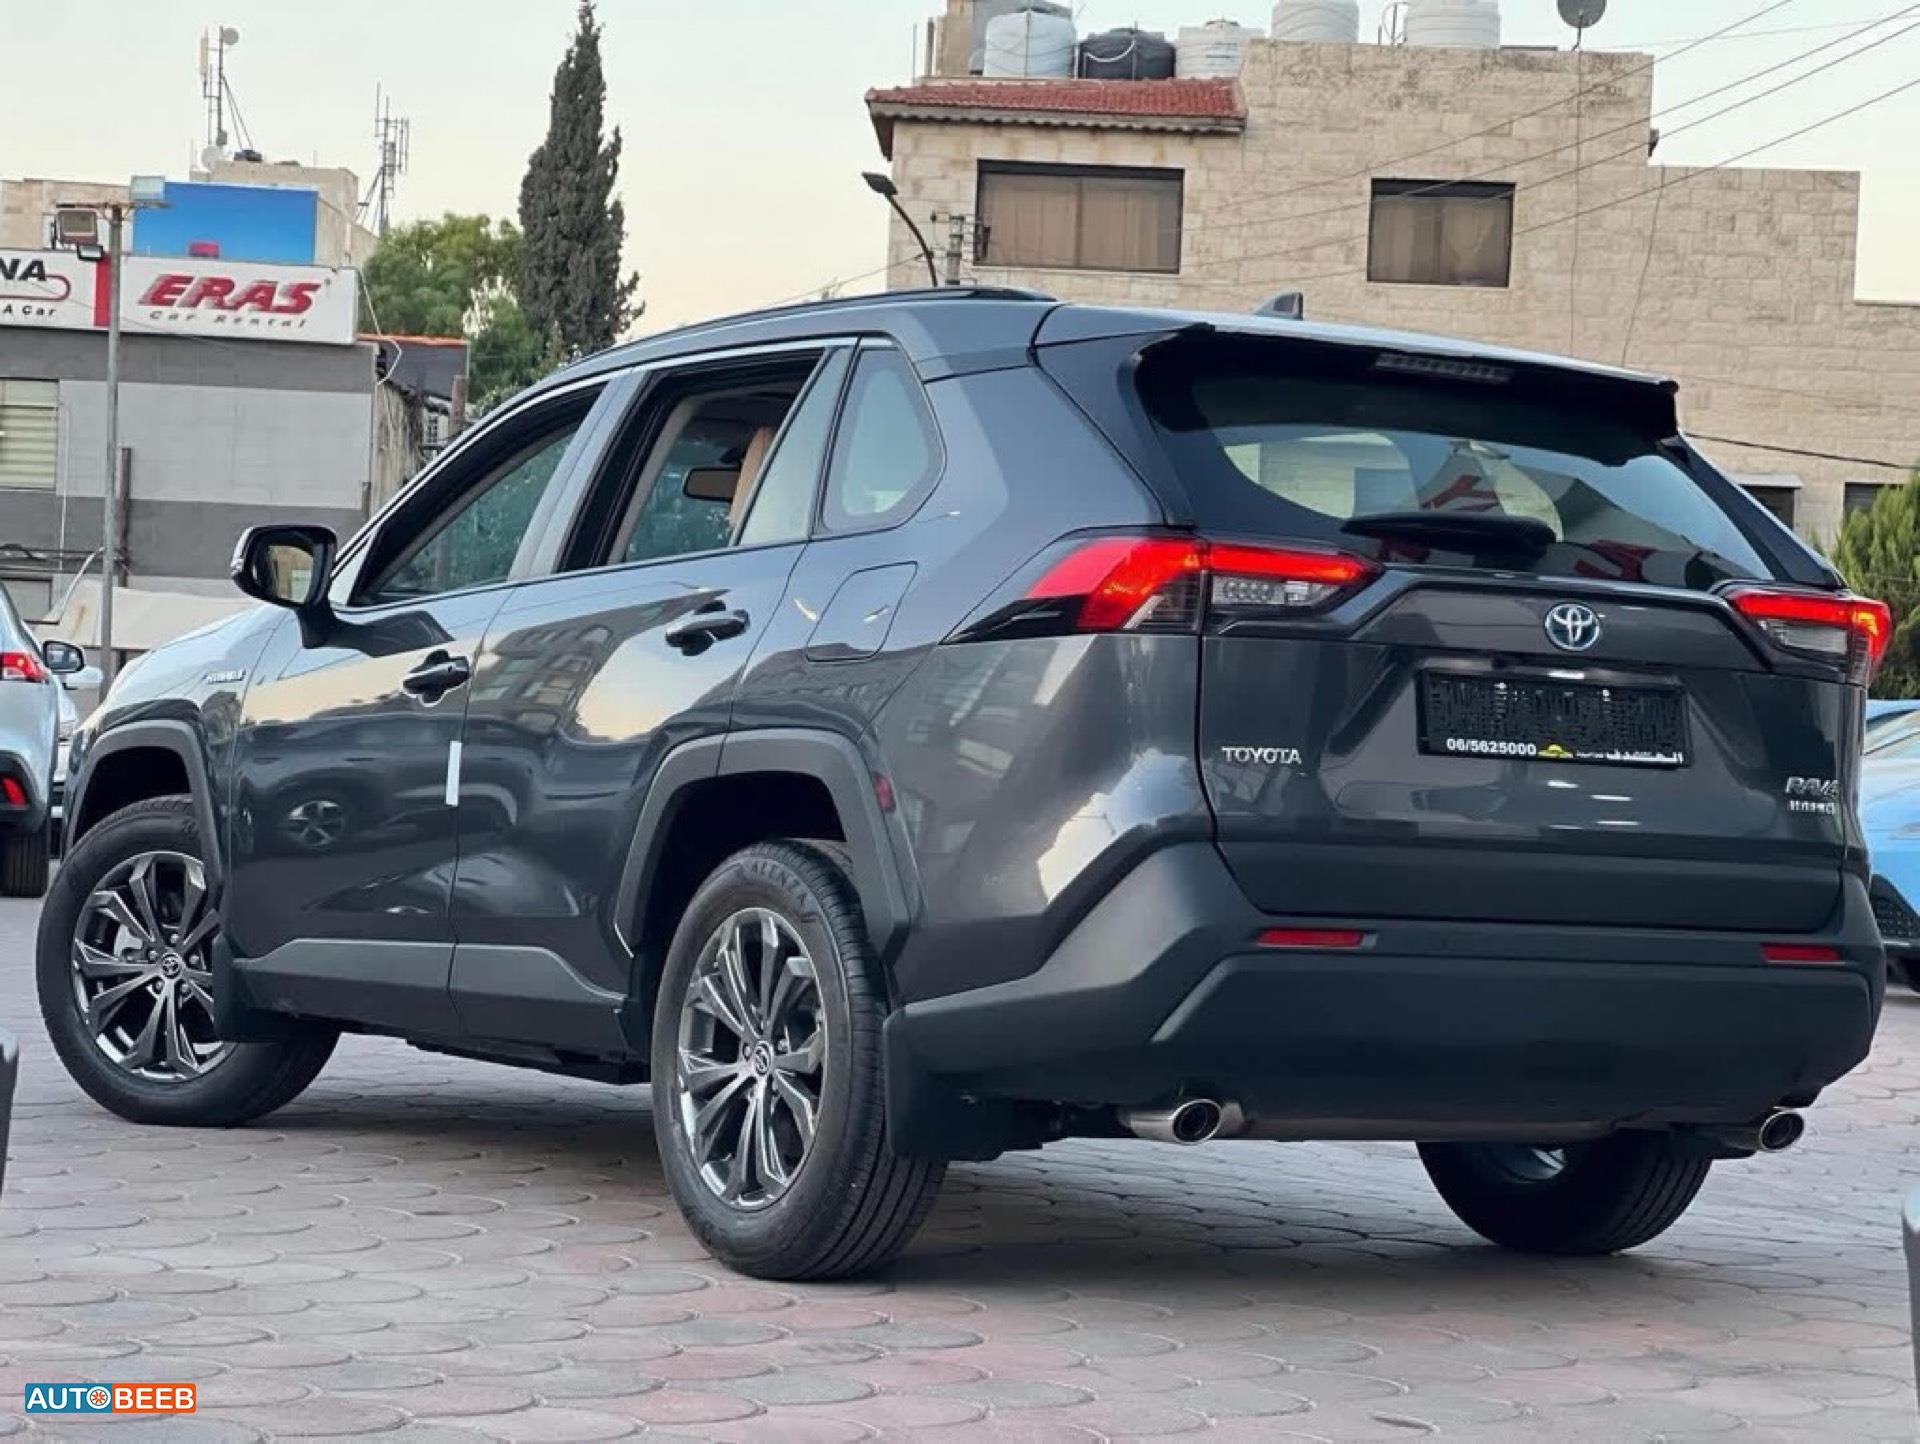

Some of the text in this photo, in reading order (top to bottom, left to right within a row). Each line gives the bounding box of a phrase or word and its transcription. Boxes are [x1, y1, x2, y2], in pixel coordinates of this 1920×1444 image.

[0, 257, 47, 281] NA
[139, 273, 322, 315] ERAS
[22, 304, 57, 316] Car
[150, 310, 307, 329] Car Rental
[1221, 746, 1302, 765] TOYOTA
[1446, 738, 1537, 756] 06/5625000
